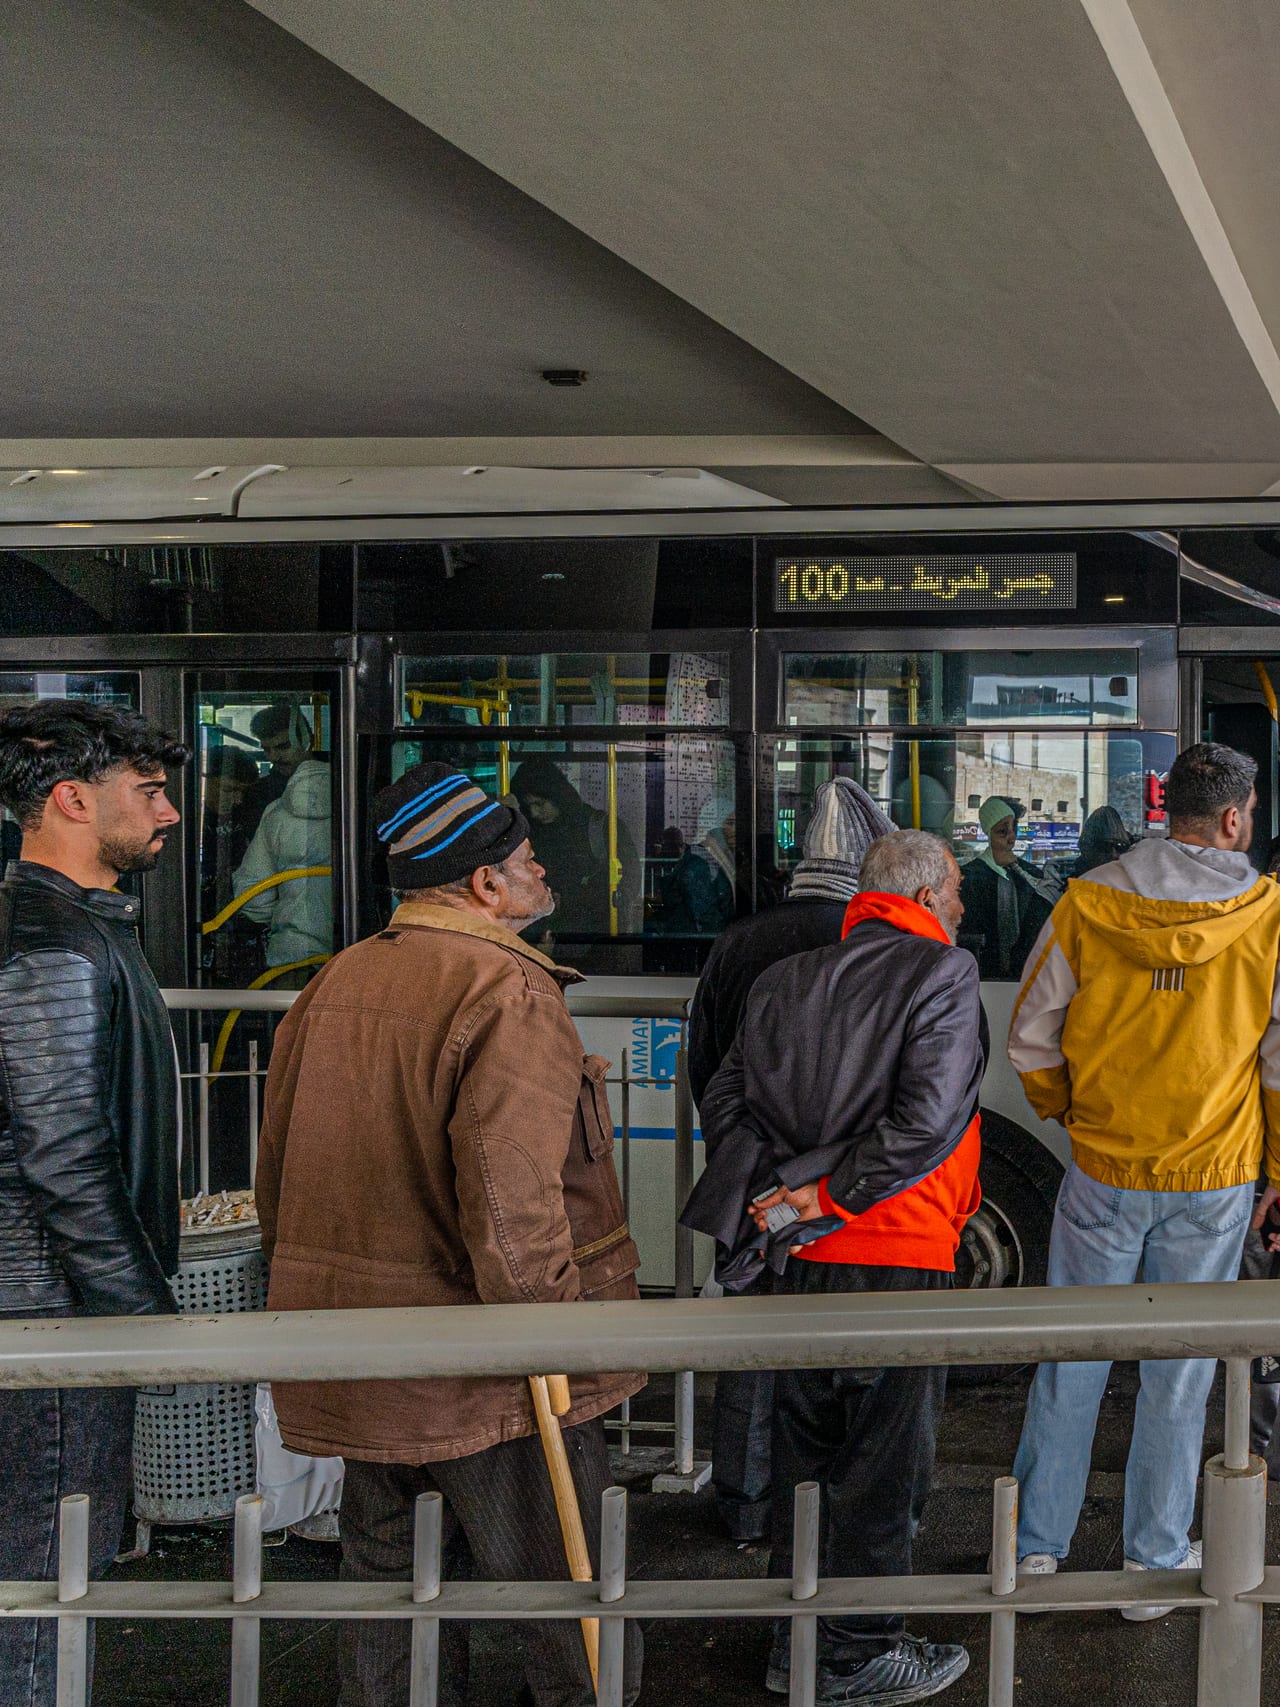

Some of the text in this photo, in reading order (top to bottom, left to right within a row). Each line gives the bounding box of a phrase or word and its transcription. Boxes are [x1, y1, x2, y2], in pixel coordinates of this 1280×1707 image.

[780, 564, 848, 601] 100
[994, 574, 1056, 598] جسر
[632, 1018, 648, 1089] AMMAN
